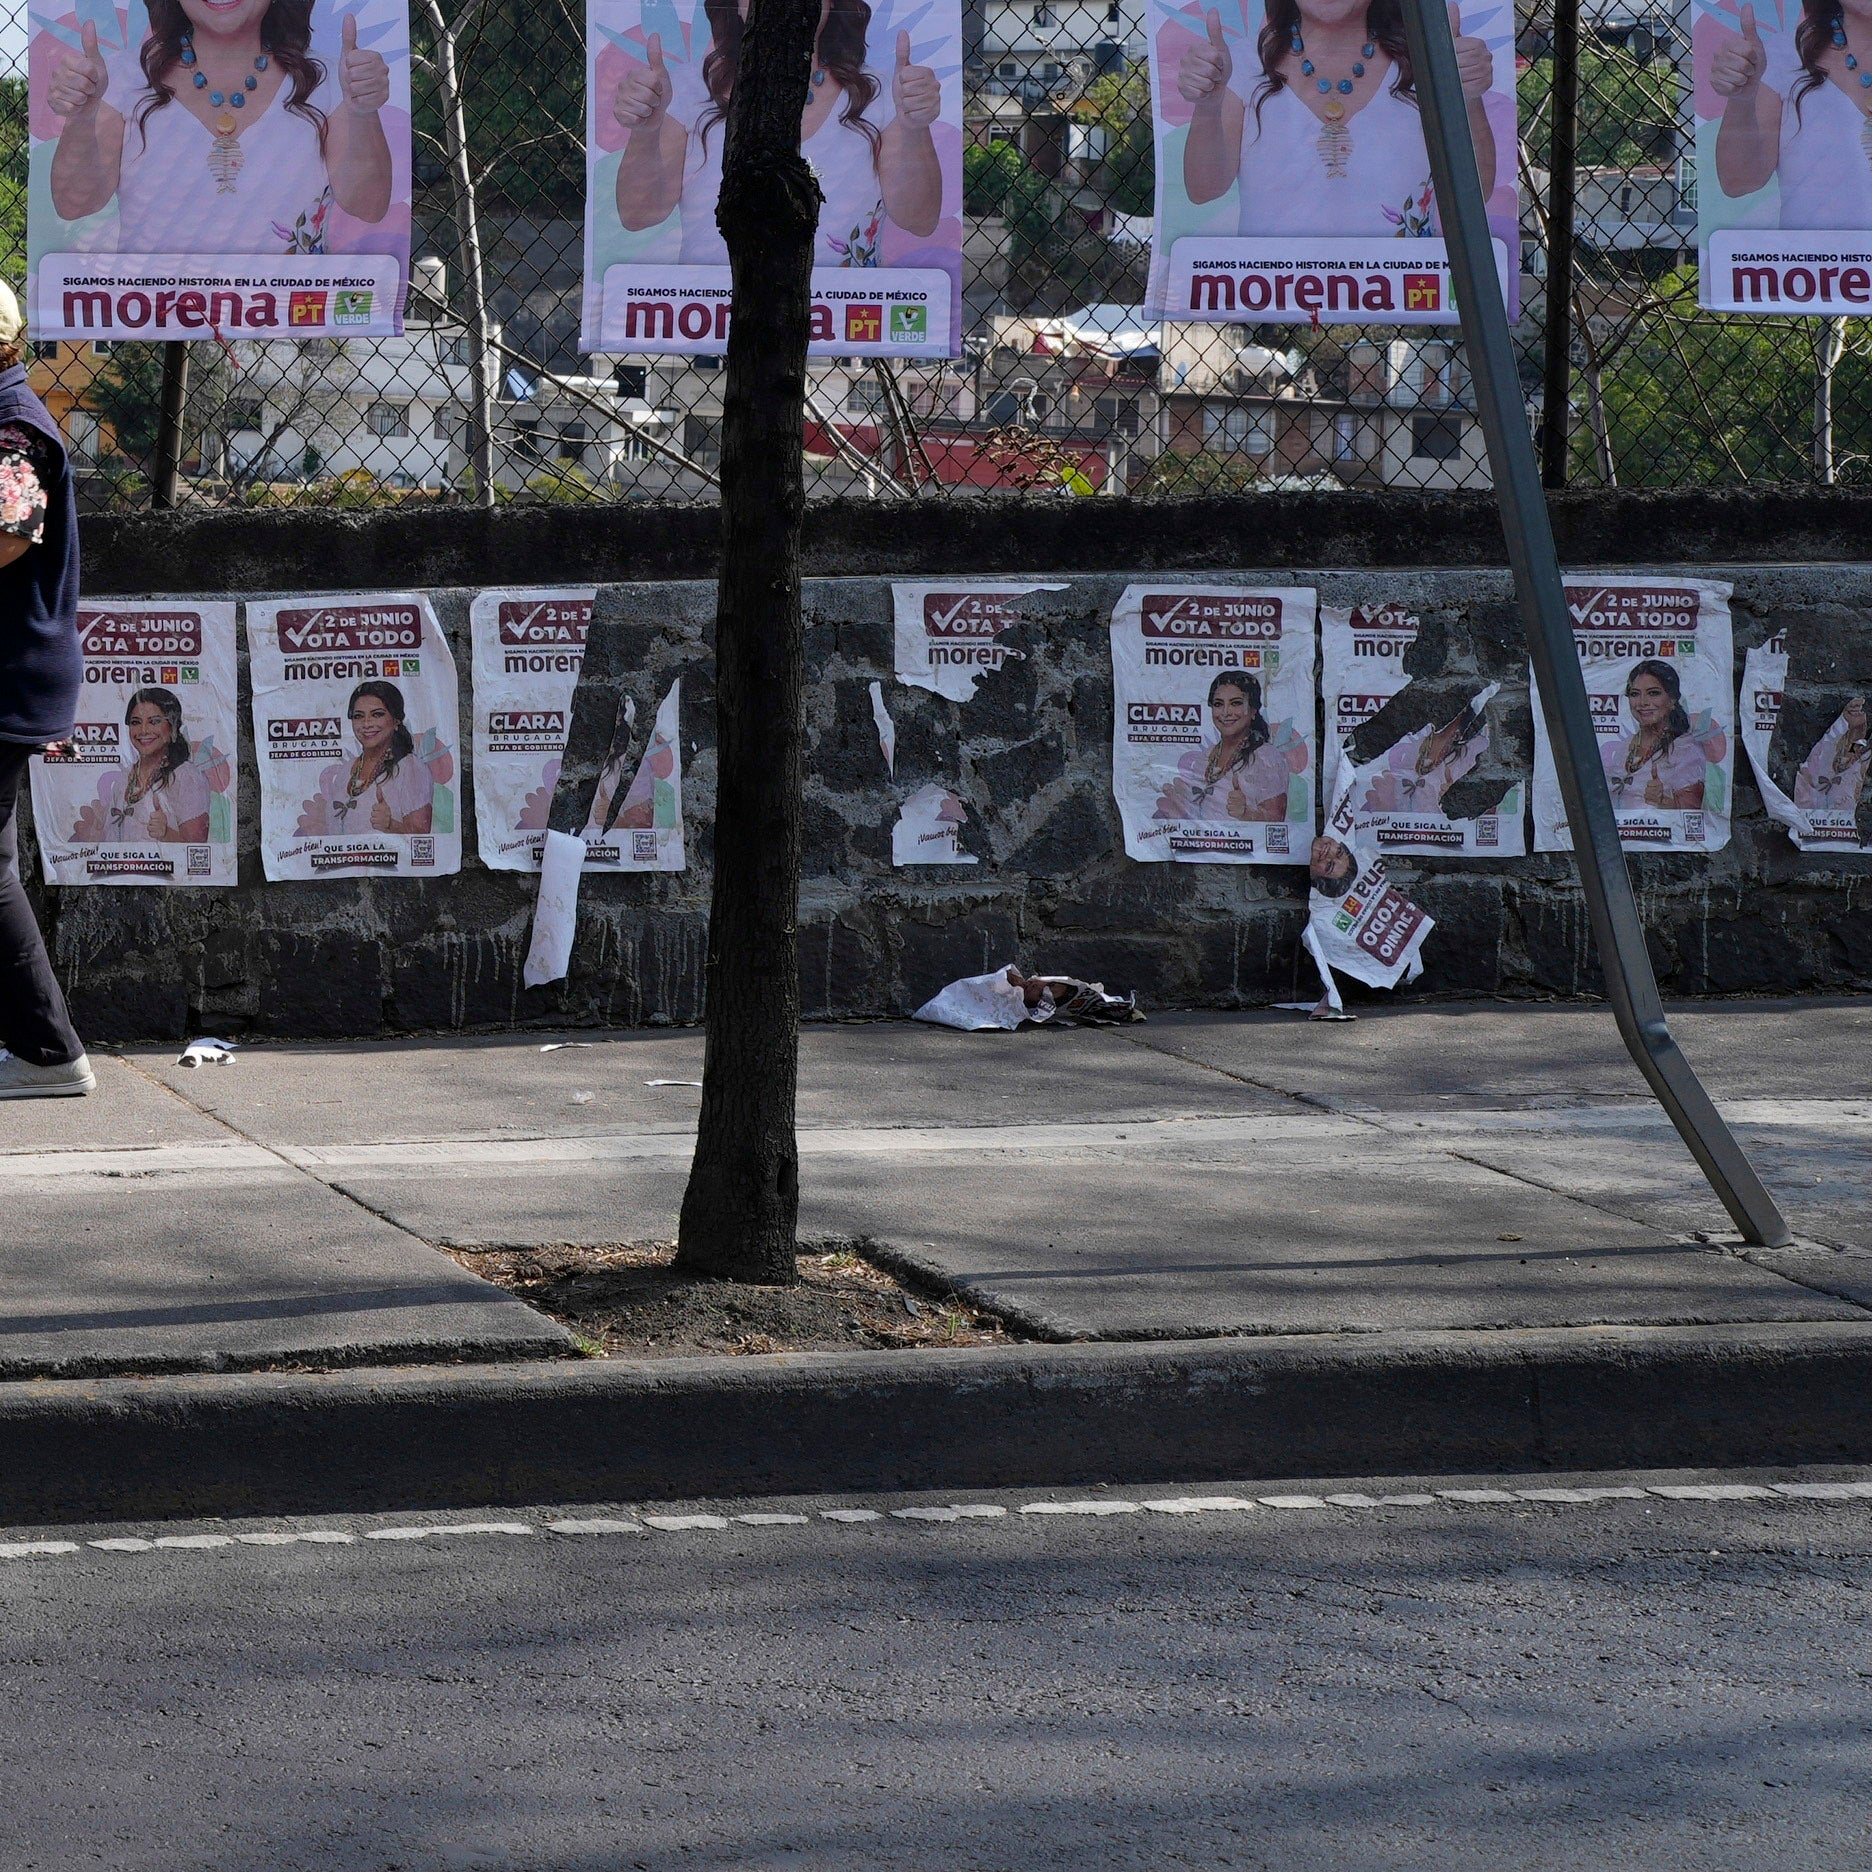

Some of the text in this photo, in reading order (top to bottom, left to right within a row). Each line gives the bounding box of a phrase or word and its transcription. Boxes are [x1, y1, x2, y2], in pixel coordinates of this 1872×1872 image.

[1190, 272, 1395, 312] morena
[1407, 288, 1438, 309] PT
[849, 318, 879, 339] PT
[324, 612, 416, 629] 2 DE JUNIO
[1145, 645, 1239, 669] morena
[283, 659, 379, 681] morena
[490, 714, 562, 731] CLARA
[1129, 705, 1199, 724] CLARA
[268, 721, 339, 739] CLARA
[1171, 837, 1252, 851] TRANSFORMACIÓN
[1379, 830, 1462, 843] TRANSFORMACIÓN
[312, 853, 397, 865] TRANSFORMACIÓN
